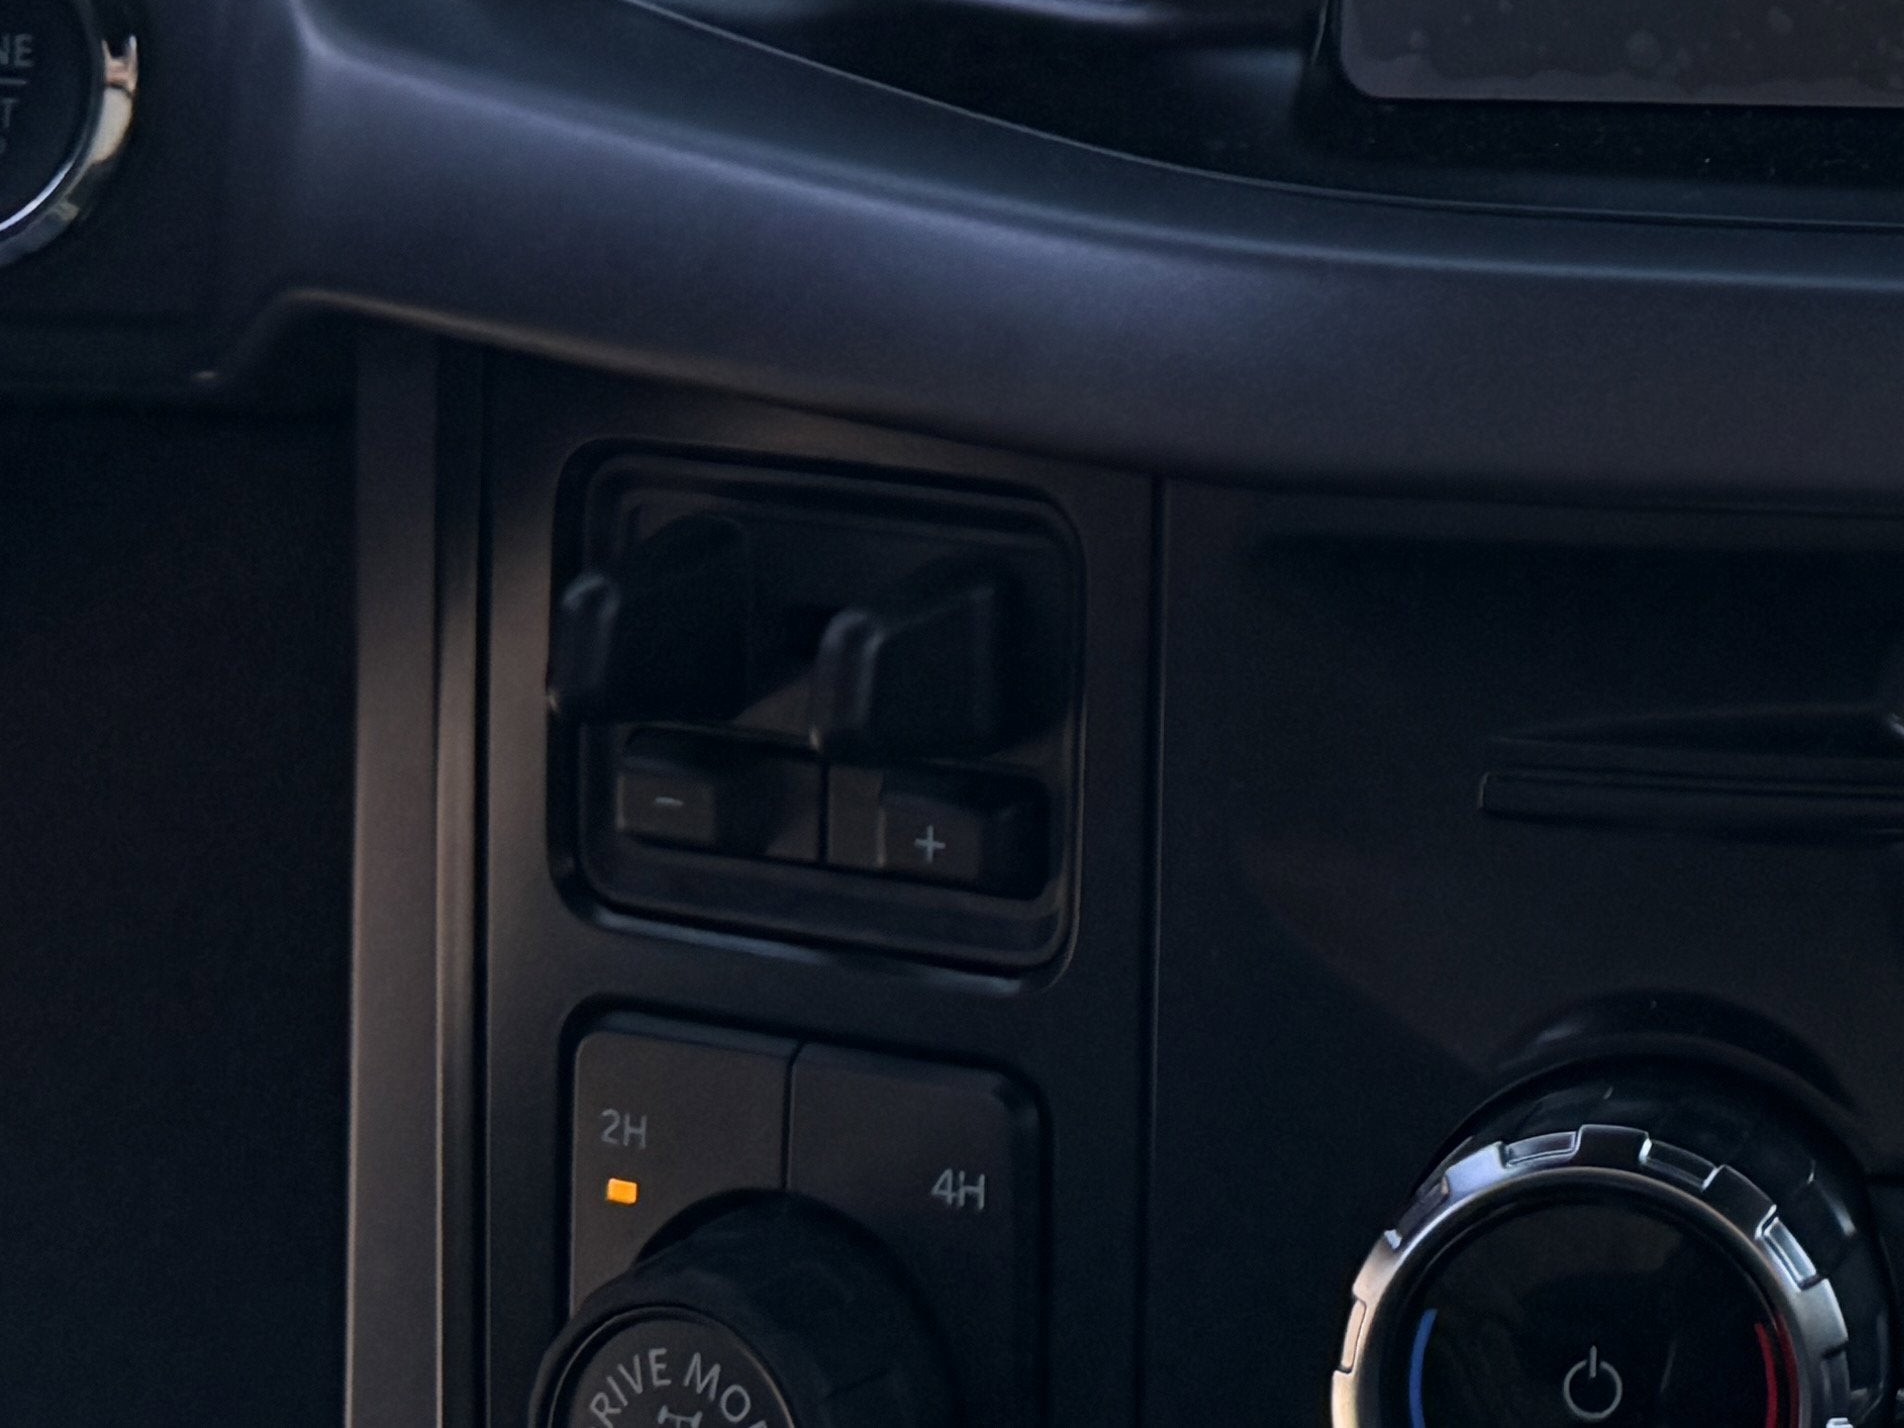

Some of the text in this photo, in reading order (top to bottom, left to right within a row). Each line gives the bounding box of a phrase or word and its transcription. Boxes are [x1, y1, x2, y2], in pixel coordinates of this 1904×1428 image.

[600, 1109, 648, 1150] 2H
[932, 1168, 986, 1210] 4H
[588, 1347, 673, 1428] RIVE
